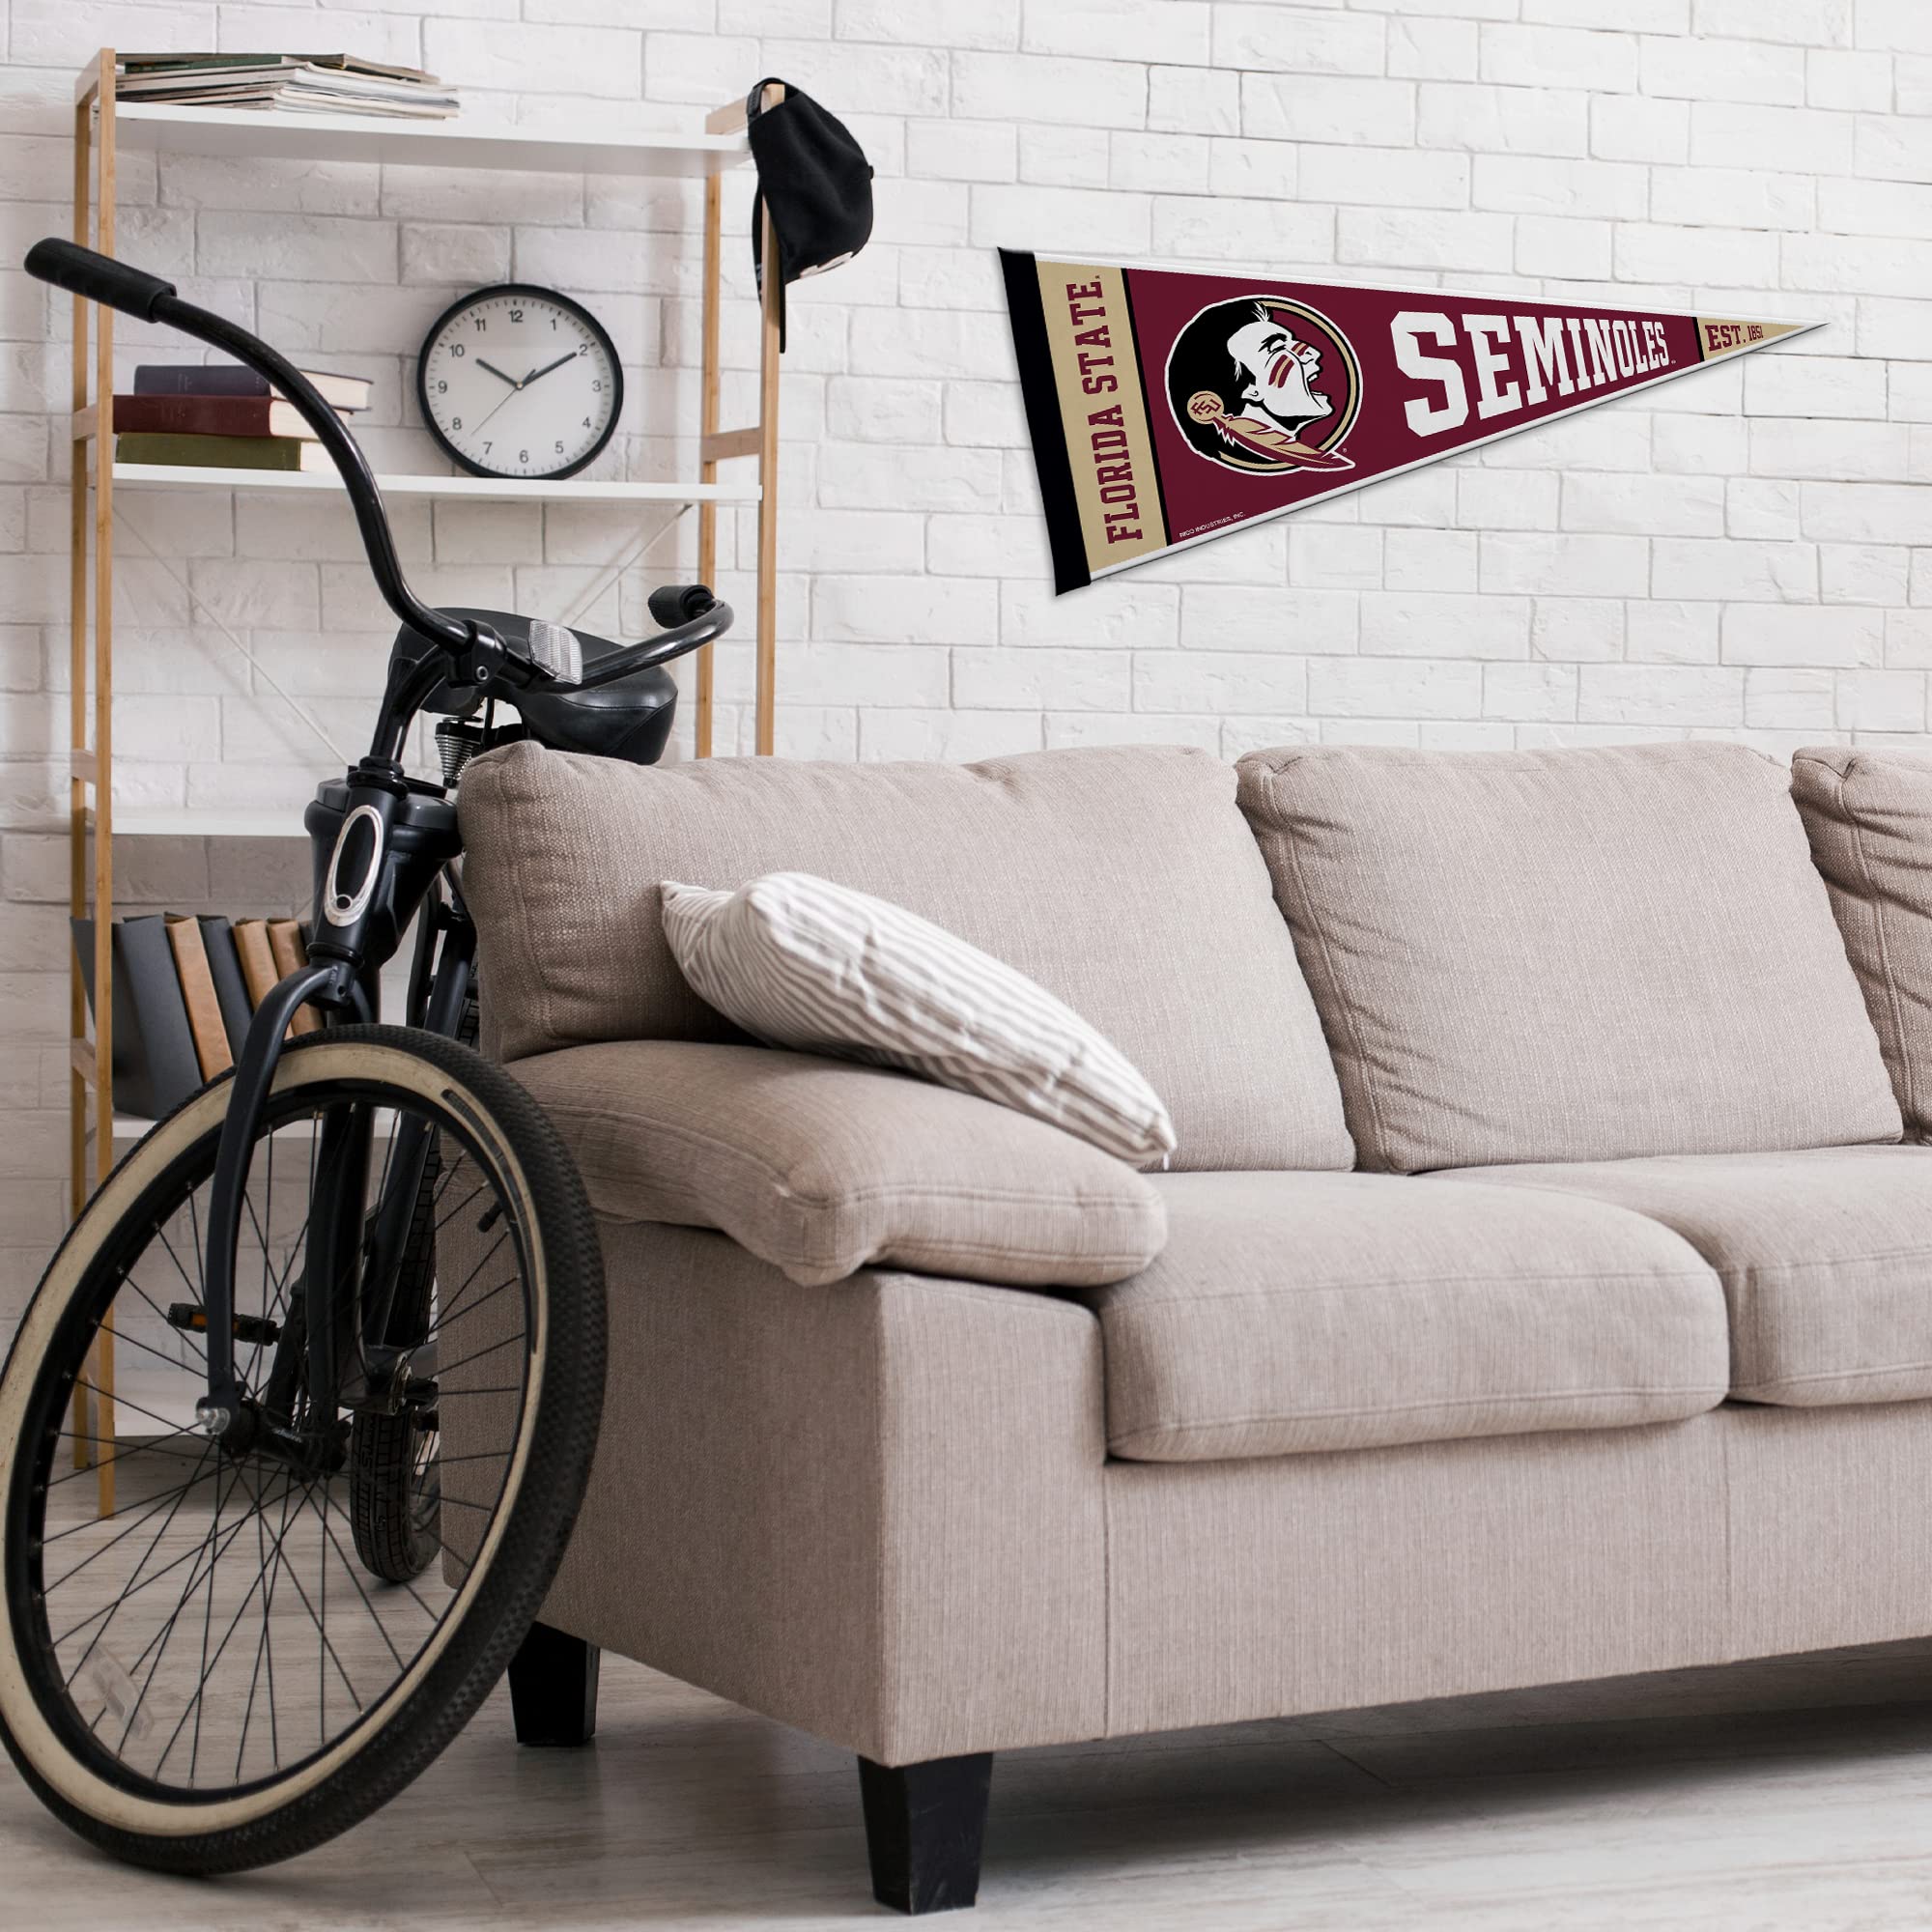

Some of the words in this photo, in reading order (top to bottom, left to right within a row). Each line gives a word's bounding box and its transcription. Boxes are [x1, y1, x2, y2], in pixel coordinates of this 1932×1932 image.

[508, 309, 524, 324] 12
[474, 318, 486, 331] 11
[550, 319, 557, 330] 1
[1704, 325, 1747, 352] EST.
[1747, 325, 1764, 341] 1851
[449, 344, 465, 357] 10
[579, 343, 588, 356] 2
[1390, 310, 1669, 438] SEMINOLES
[438, 381, 448, 394] 9
[591, 380, 602, 392] 3
[451, 417, 462, 431] 8
[582, 416, 591, 428] 4
[483, 441, 493, 455] 7
[554, 440, 564, 454] 5
[519, 450, 529, 464] 6
[1087, 404, 1143, 544] FLORIDA
